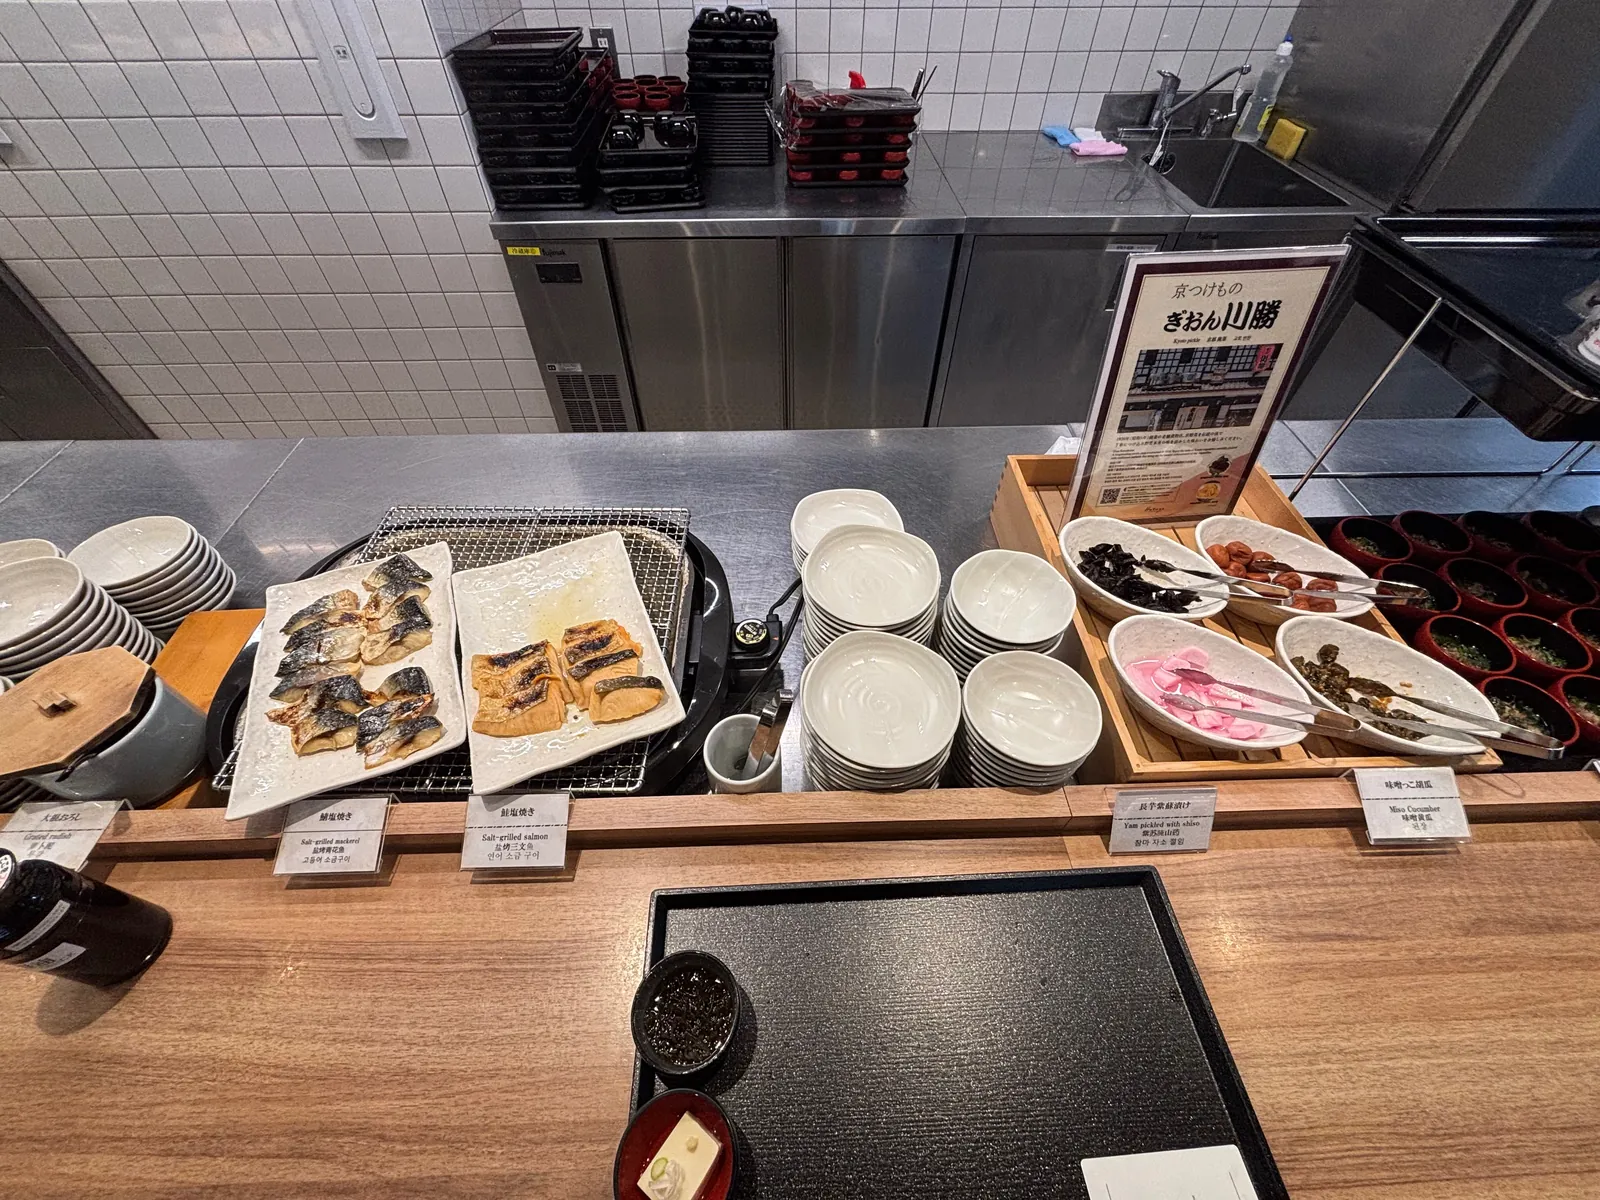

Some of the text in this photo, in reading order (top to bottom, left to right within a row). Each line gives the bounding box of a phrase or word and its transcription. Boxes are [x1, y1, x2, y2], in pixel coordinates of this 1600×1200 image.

[1171, 282, 1243, 299] 京つけもの
[1163, 300, 1282, 332] ぎおん川勝
[1139, 801, 1192, 811] 長芋紫蘇漬け
[1389, 805, 1440, 813] Miso Cucumber
[319, 812, 353, 821] 鯖塩焼き
[500, 807, 535, 818] 鮭塩焼き
[1140, 821, 1164, 830] pickled
[1166, 820, 1181, 828] with
[24, 833, 48, 841] Grated
[300, 838, 334, 846] Salt-grilled
[482, 832, 522, 842] Salt-grilled
[302, 856, 323, 864] 고등어
[487, 851, 540, 861] 연어 소금 구이
